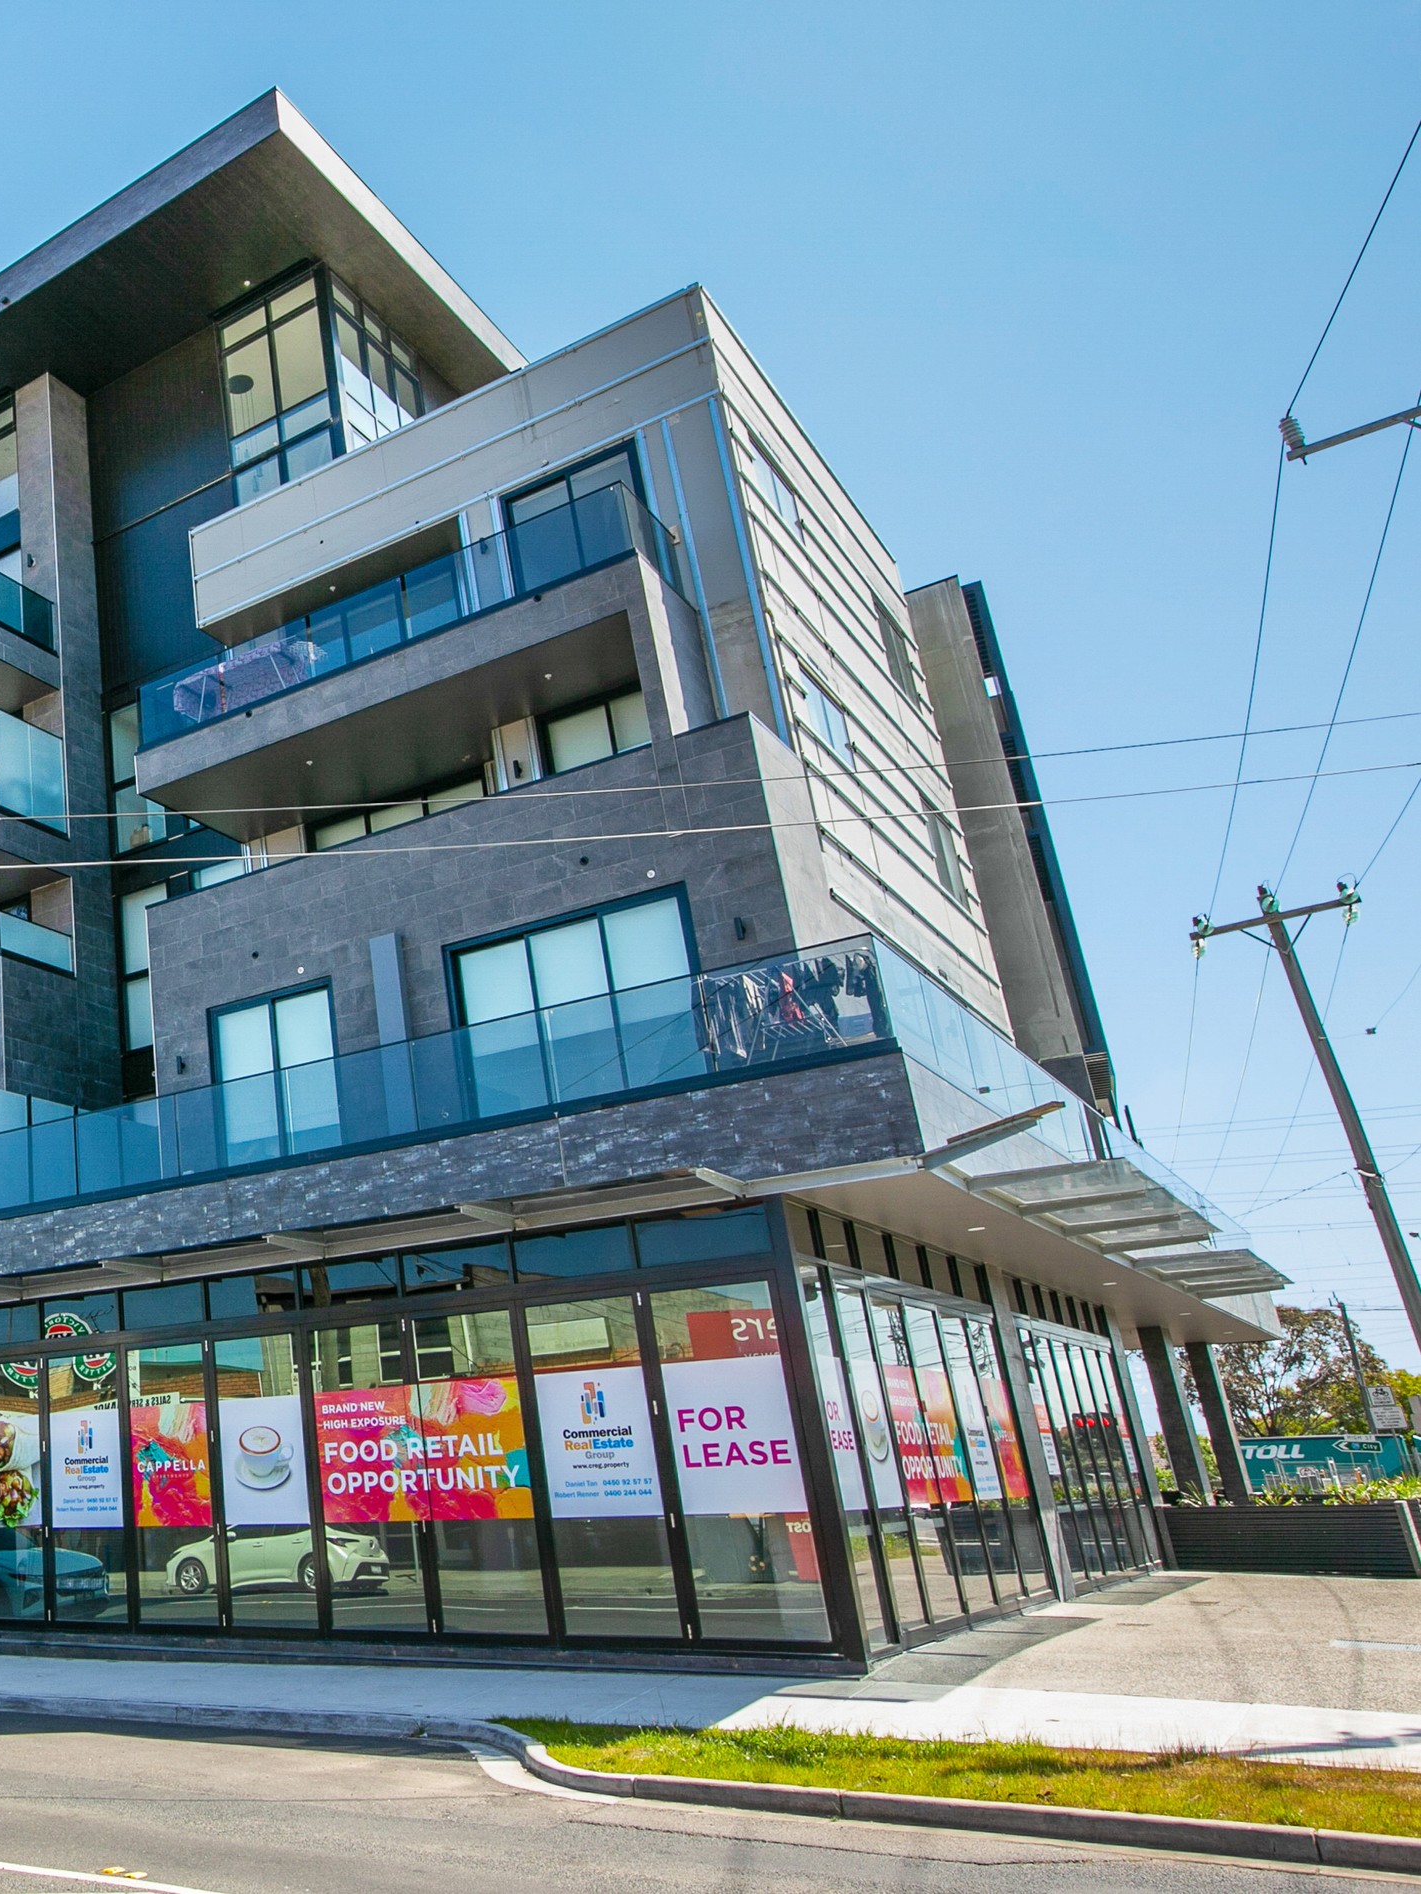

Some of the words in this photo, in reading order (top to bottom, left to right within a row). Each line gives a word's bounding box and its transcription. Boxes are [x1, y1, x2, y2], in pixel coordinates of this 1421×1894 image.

[321, 1403, 358, 1415] BRAND
[360, 1401, 386, 1412] NEW
[323, 1418, 349, 1430] HIGH
[350, 1415, 407, 1428] EXPOSURE
[677, 1405, 748, 1433] FOR
[563, 1426, 633, 1440] Commercial
[894, 1420, 922, 1446] FOOD
[564, 1438, 634, 1451] RealEstate
[831, 1430, 855, 1451] EASE
[323, 1439, 398, 1465] FOOD
[406, 1432, 505, 1460] RETAIL
[585, 1451, 615, 1460] Group
[682, 1439, 792, 1469] LEASE
[1240, 1444, 1305, 1460] TOLL
[64, 1456, 109, 1466] Commercial
[137, 1459, 206, 1473] CAPPELLA
[572, 1462, 630, 1470] www.creg.property
[64, 1465, 110, 1475] RealEstate
[77, 1475, 97, 1483] Group
[327, 1464, 521, 1495] OPPORTUNITY
[554, 1491, 576, 1499] Robert
[576, 1490, 600, 1498] Renner
